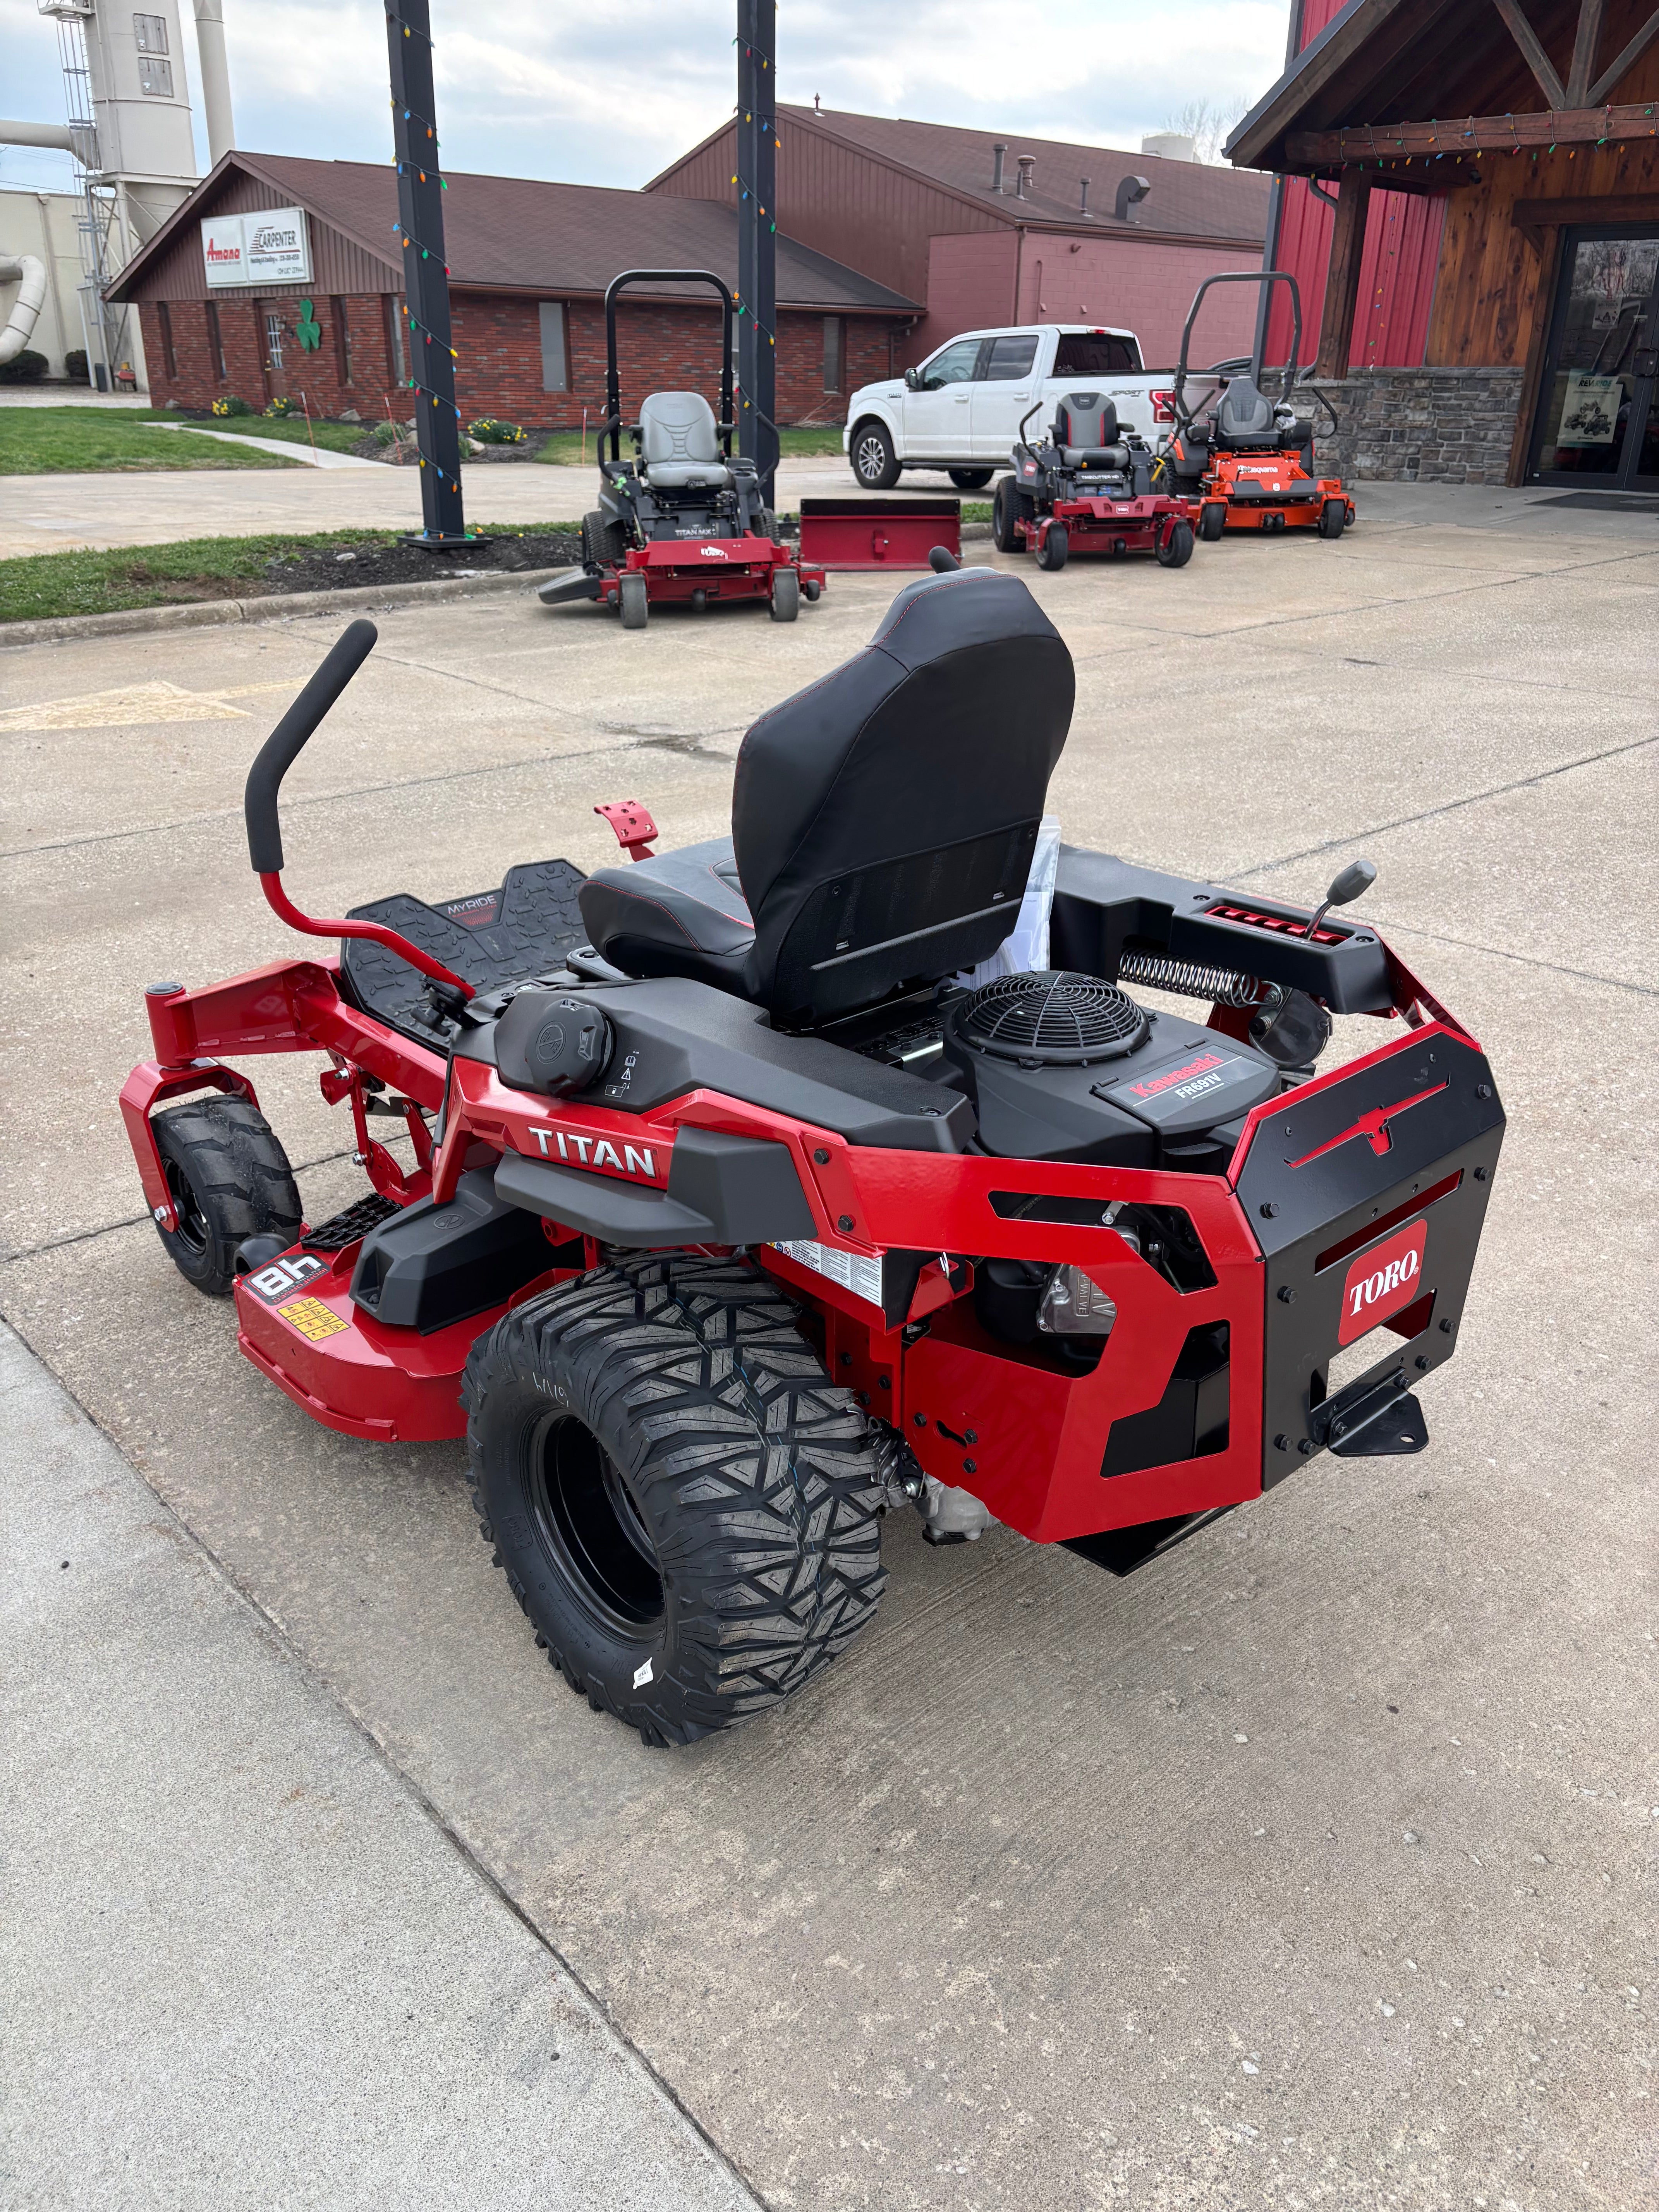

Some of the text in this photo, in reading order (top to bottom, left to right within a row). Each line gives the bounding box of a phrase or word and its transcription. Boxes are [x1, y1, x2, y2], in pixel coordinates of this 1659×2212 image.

[206, 238, 240, 261] Amana
[259, 230, 296, 248] CARPENTER
[1130, 1053, 1224, 1097] Kawasaki
[1175, 1073, 1221, 1098] FR691V
[528, 1127, 656, 1178] TITAN
[248, 1256, 321, 1296] 48
[271, 1268, 321, 1300] CUTTING SYSTEM
[273, 1268, 328, 1303] IRONFORGED
